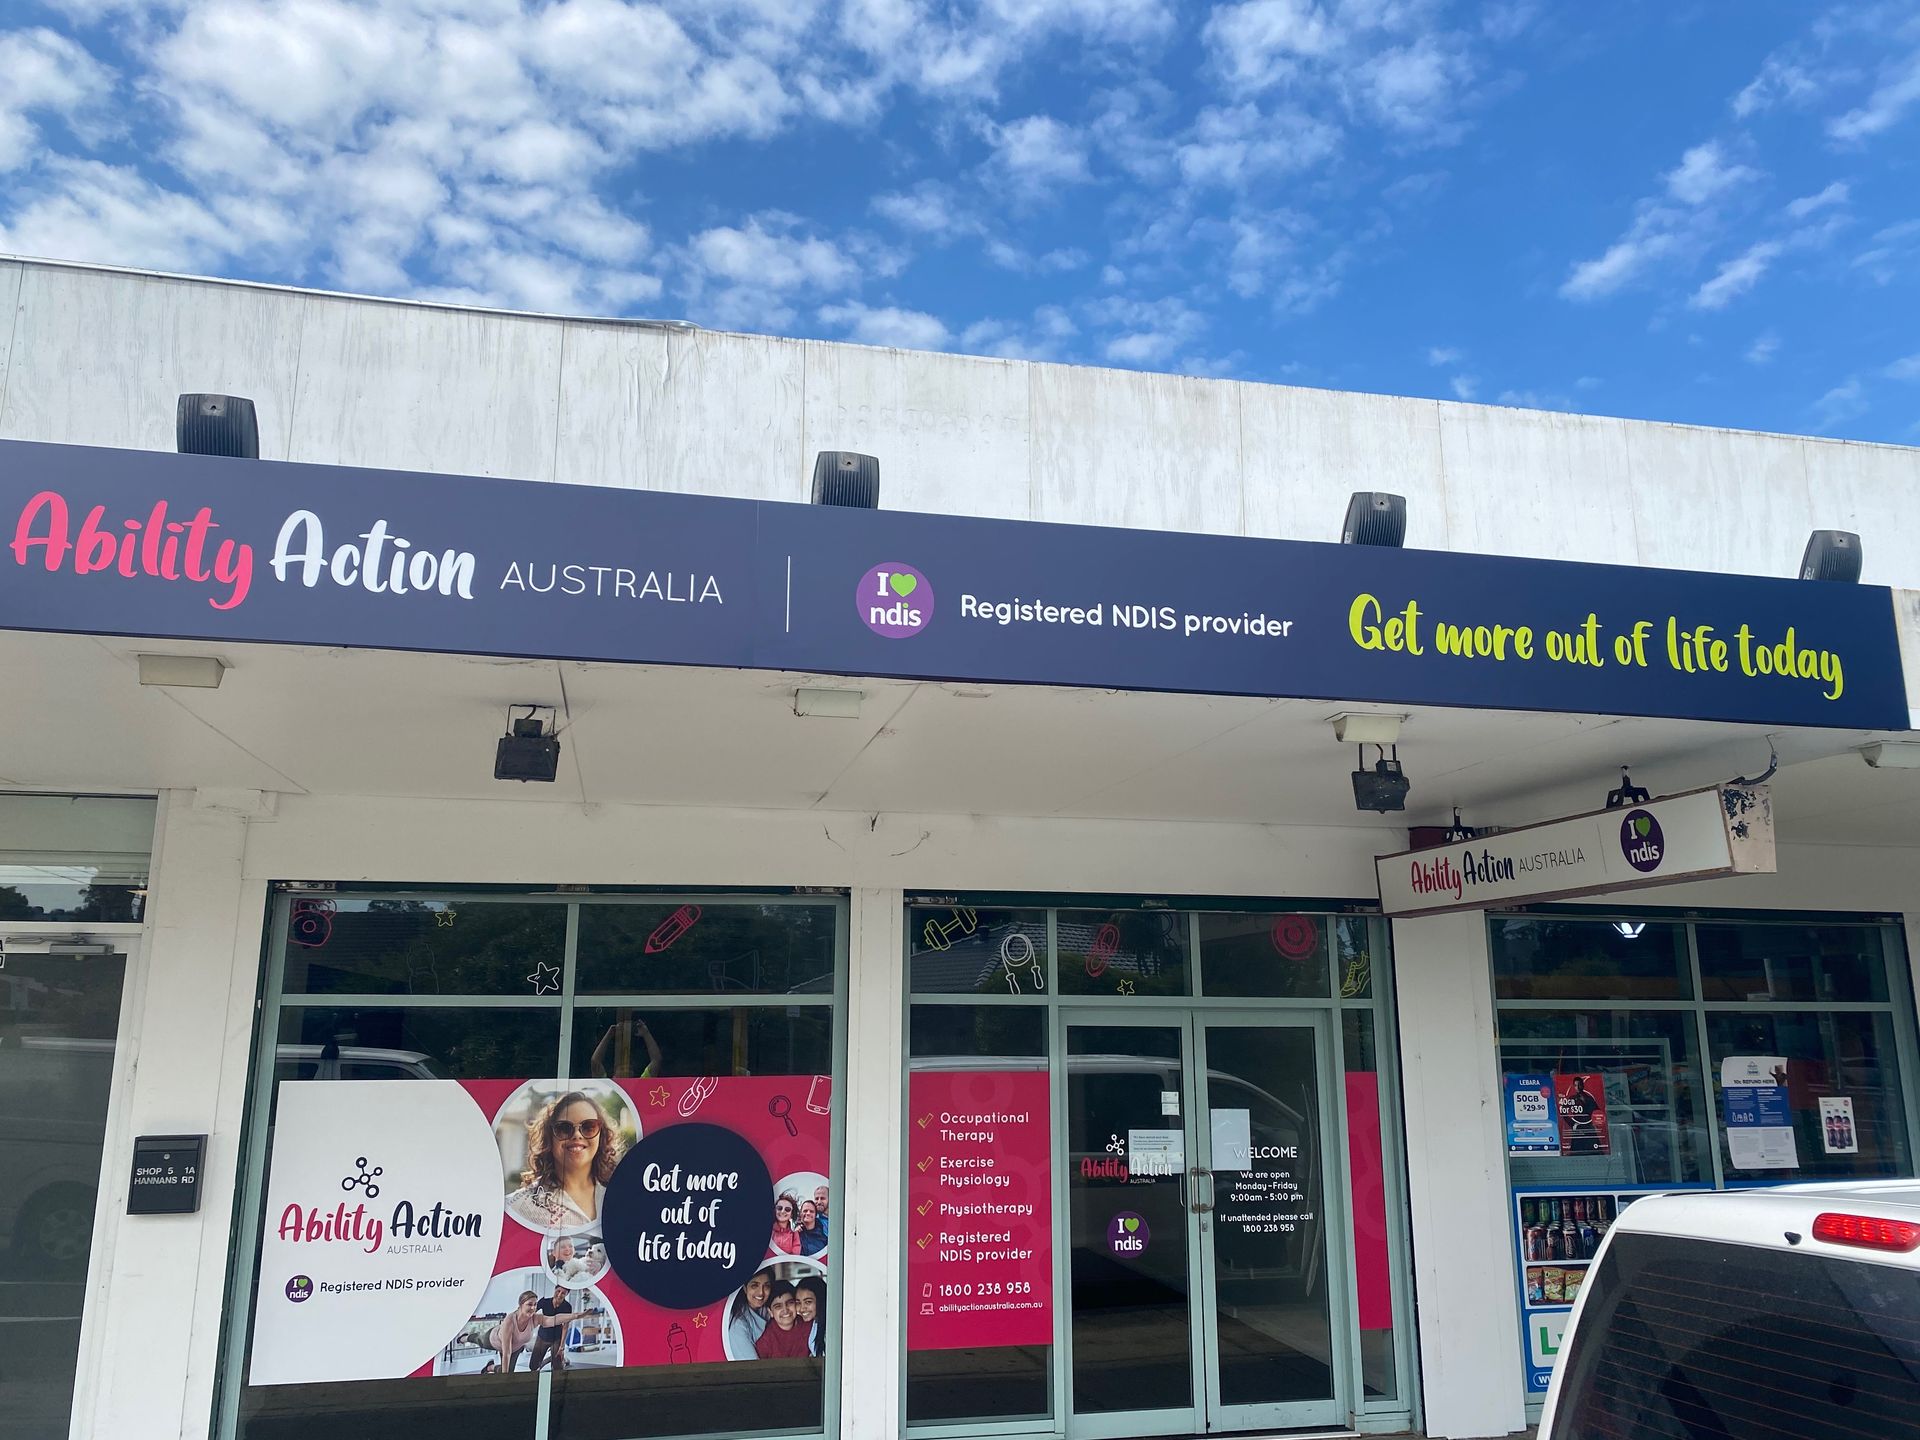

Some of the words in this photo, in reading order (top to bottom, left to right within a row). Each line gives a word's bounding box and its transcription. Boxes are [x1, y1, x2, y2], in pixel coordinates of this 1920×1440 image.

[10, 491, 253, 611] Ability
[269, 510, 477, 601] Action
[500, 561, 723, 604] AUSTRALIA
[877, 572, 889, 597] I
[870, 602, 922, 627] ndis
[961, 594, 1102, 625] Registered
[1112, 604, 1177, 630] NDIS
[1184, 612, 1293, 637] provider
[1348, 593, 1423, 656] Get
[1436, 621, 1534, 661] more
[1546, 613, 1604, 668] out
[1614, 621, 1654, 667] of
[1667, 616, 1728, 674] life
[1734, 623, 1844, 700] today
[1628, 819, 1637, 840] I
[1630, 841, 1660, 864] ndis
[1410, 857, 1462, 900] Ability
[1463, 848, 1516, 886] Action
[1519, 847, 1585, 873] AUSTRALIA
[1516, 1094, 1539, 1103] 50GB
[940, 1112, 1029, 1125] Occupational
[940, 1129, 994, 1143] Therapy
[1233, 1147, 1298, 1159] WELCOME
[940, 1156, 995, 1168] Exercise
[136, 1167, 162, 1176] SHOP
[167, 1167, 174, 1175] 5
[185, 1166, 196, 1174] 1A
[642, 1162, 681, 1193] Get
[686, 1169, 739, 1192] more
[1080, 1157, 1128, 1184] Ability
[1130, 1156, 1173, 1177] Action
[1240, 1171, 1253, 1179] We
[1270, 1172, 1290, 1180] open
[134, 1176, 178, 1185] HANNANS
[181, 1176, 195, 1184] RD
[940, 1173, 1010, 1188] Physiology
[1230, 1193, 1263, 1202] 9:00am
[1270, 1192, 1289, 1201] 5:00
[1290, 1194, 1304, 1202] pm
[660, 1196, 693, 1225] out
[699, 1198, 723, 1228] of
[940, 1201, 1033, 1217] Physiotherapy
[1220, 1214, 1226, 1222] If
[1227, 1213, 1271, 1222] unattended
[1273, 1213, 1298, 1222] please
[1299, 1212, 1314, 1220] call
[278, 1202, 383, 1254] Ability
[390, 1200, 482, 1239] Action
[1118, 1218, 1124, 1233] I
[1243, 1225, 1262, 1233] 1800
[1263, 1224, 1278, 1232] 238
[1280, 1224, 1295, 1232] 958
[939, 1230, 1011, 1246] Registered
[1114, 1236, 1143, 1251] ndis
[387, 1244, 443, 1255] AUSTRALIA
[638, 1232, 671, 1262] life
[676, 1231, 736, 1269] today
[939, 1249, 972, 1262] NDIS
[976, 1248, 1033, 1263] provider
[320, 1281, 382, 1294] Registered
[385, 1279, 414, 1290] NDIS
[416, 1277, 465, 1291] provider
[939, 1284, 972, 1296] 1800
[977, 1283, 1001, 1295] 238
[1006, 1282, 1031, 1294] 958
[289, 1289, 309, 1299] ndis
[939, 1301, 1043, 1312] abilityactionaustralia.com.au
